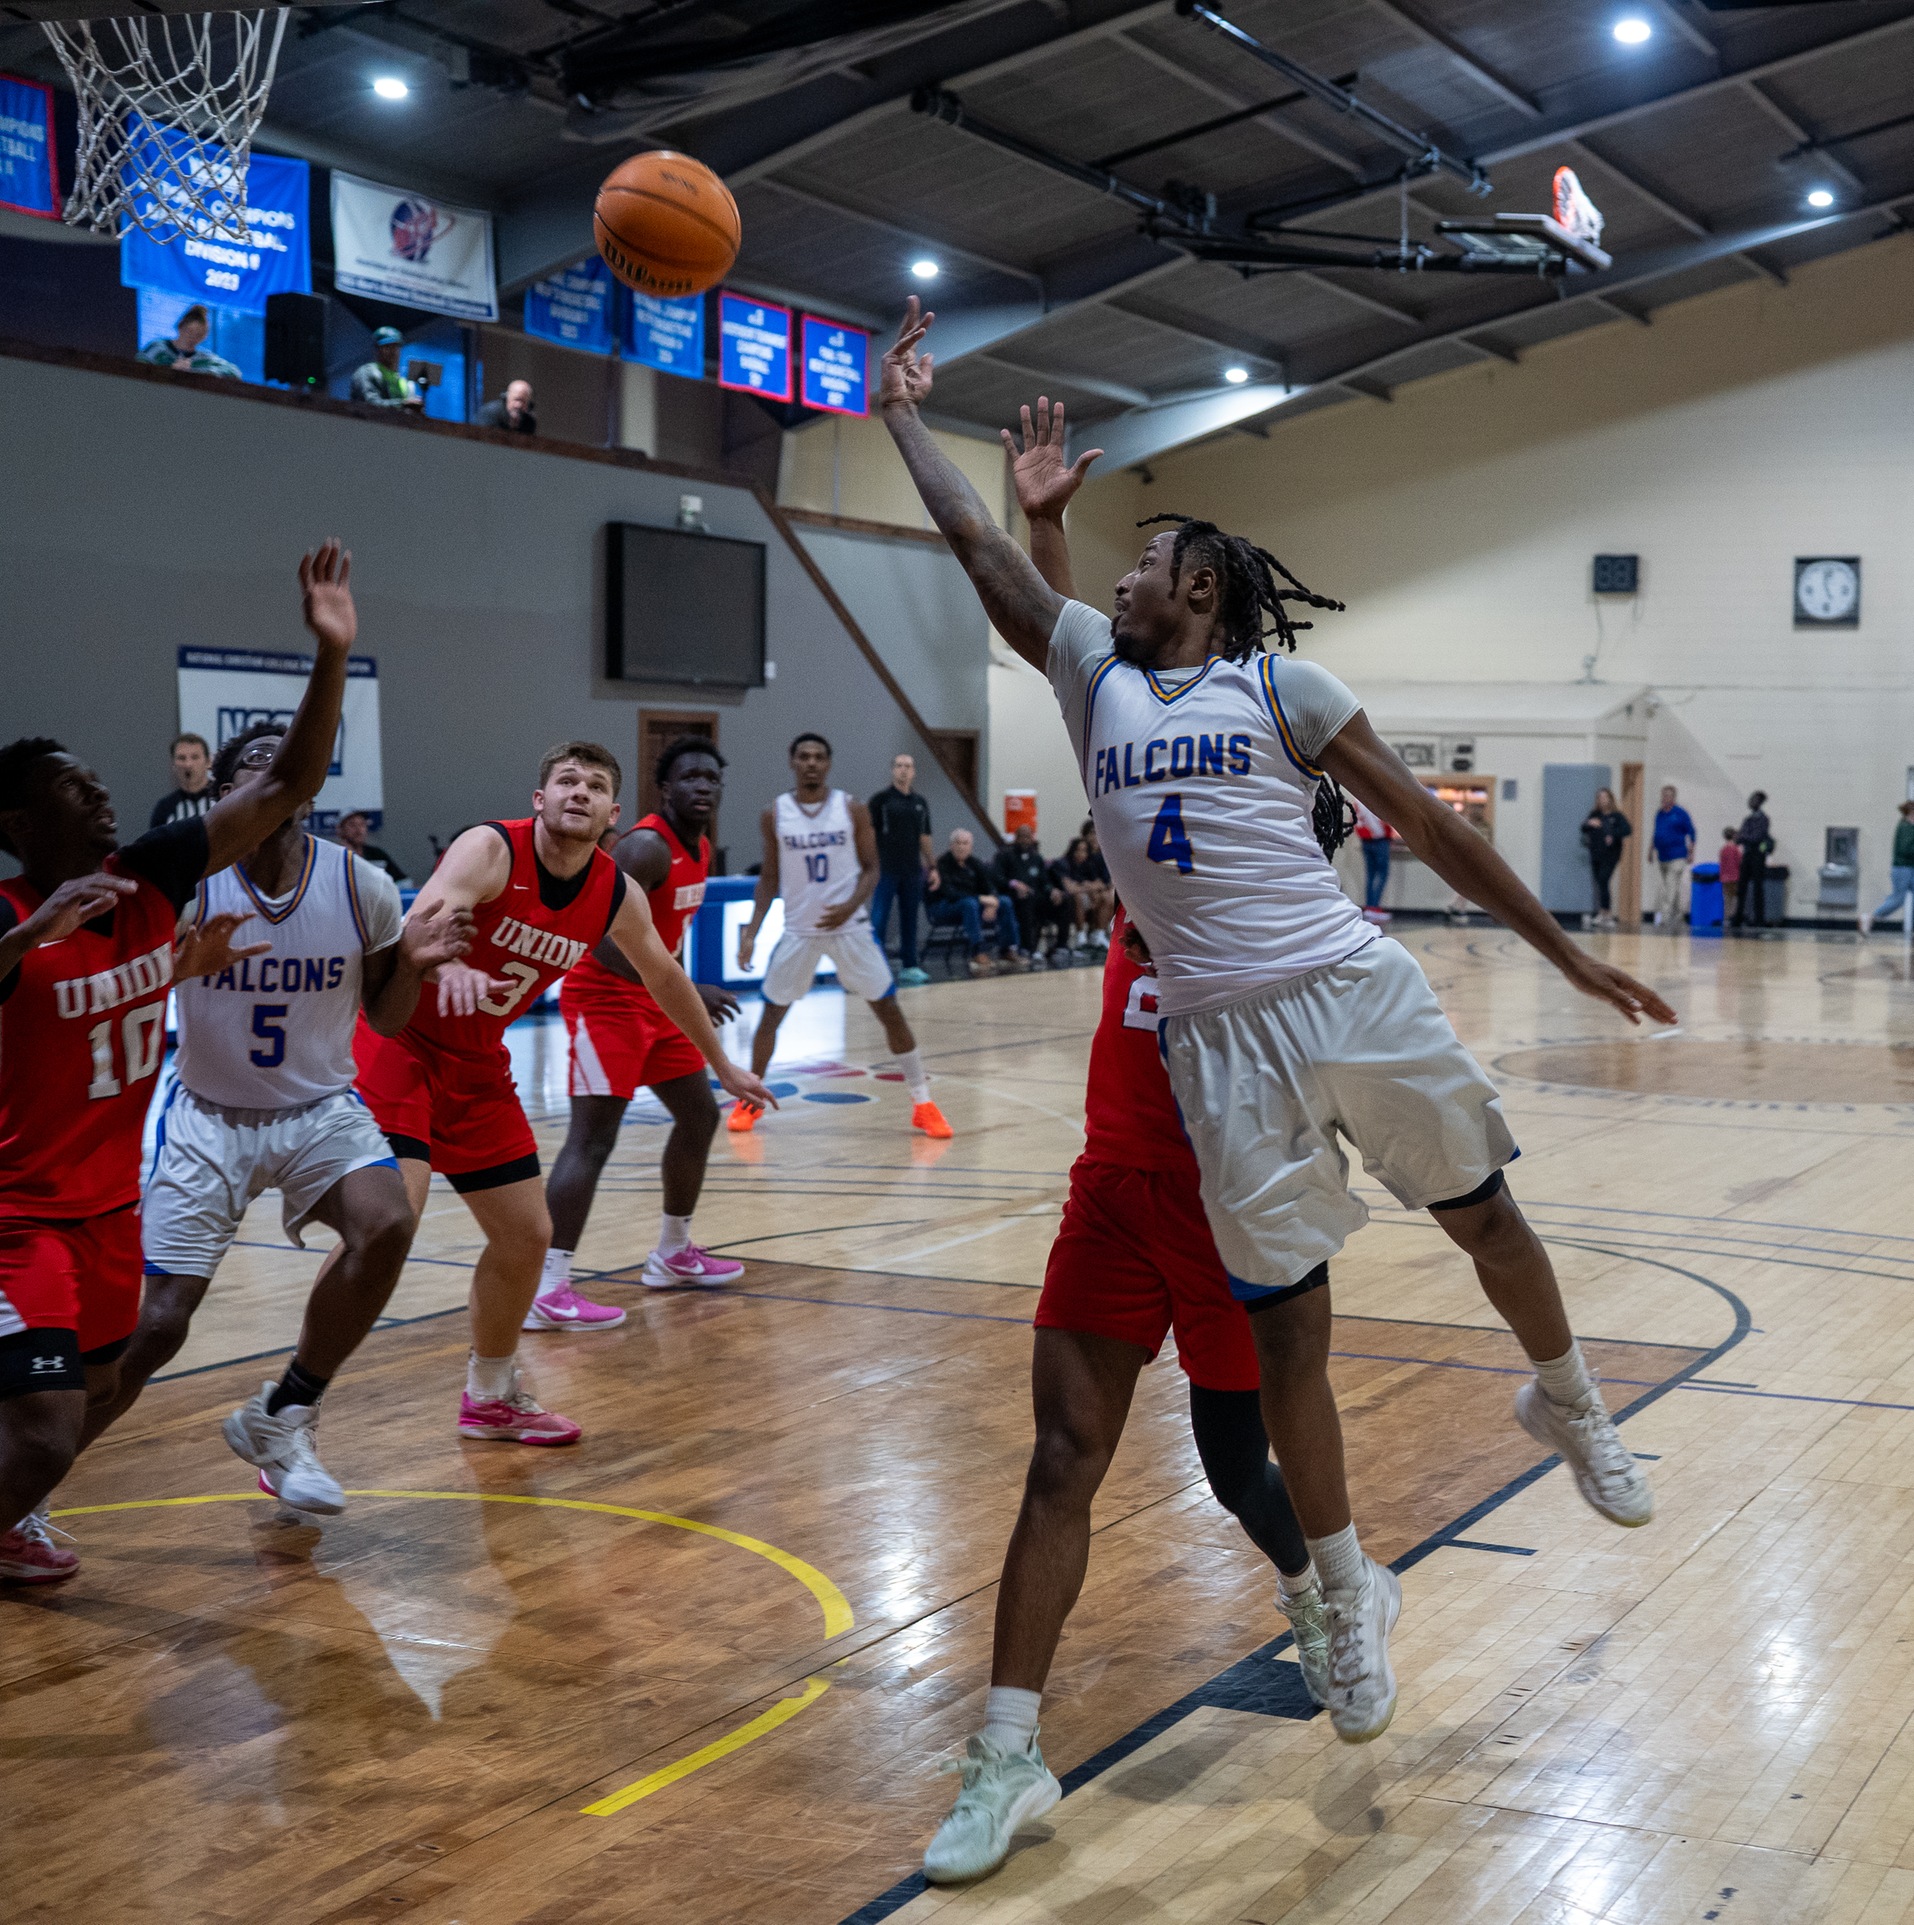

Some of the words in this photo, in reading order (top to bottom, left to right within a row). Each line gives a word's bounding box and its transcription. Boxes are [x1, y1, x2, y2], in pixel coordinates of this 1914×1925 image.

[1095, 733, 1251, 799] FALCONS
[783, 830, 847, 850] FALCONS
[1147, 793, 1195, 875] 4
[805, 852, 829, 883] 10
[490, 915, 589, 971] UNION
[53, 940, 174, 1020] UNION
[476, 960, 540, 1017] 3
[88, 1000, 165, 1100] 10
[250, 1004, 288, 1068] 5
